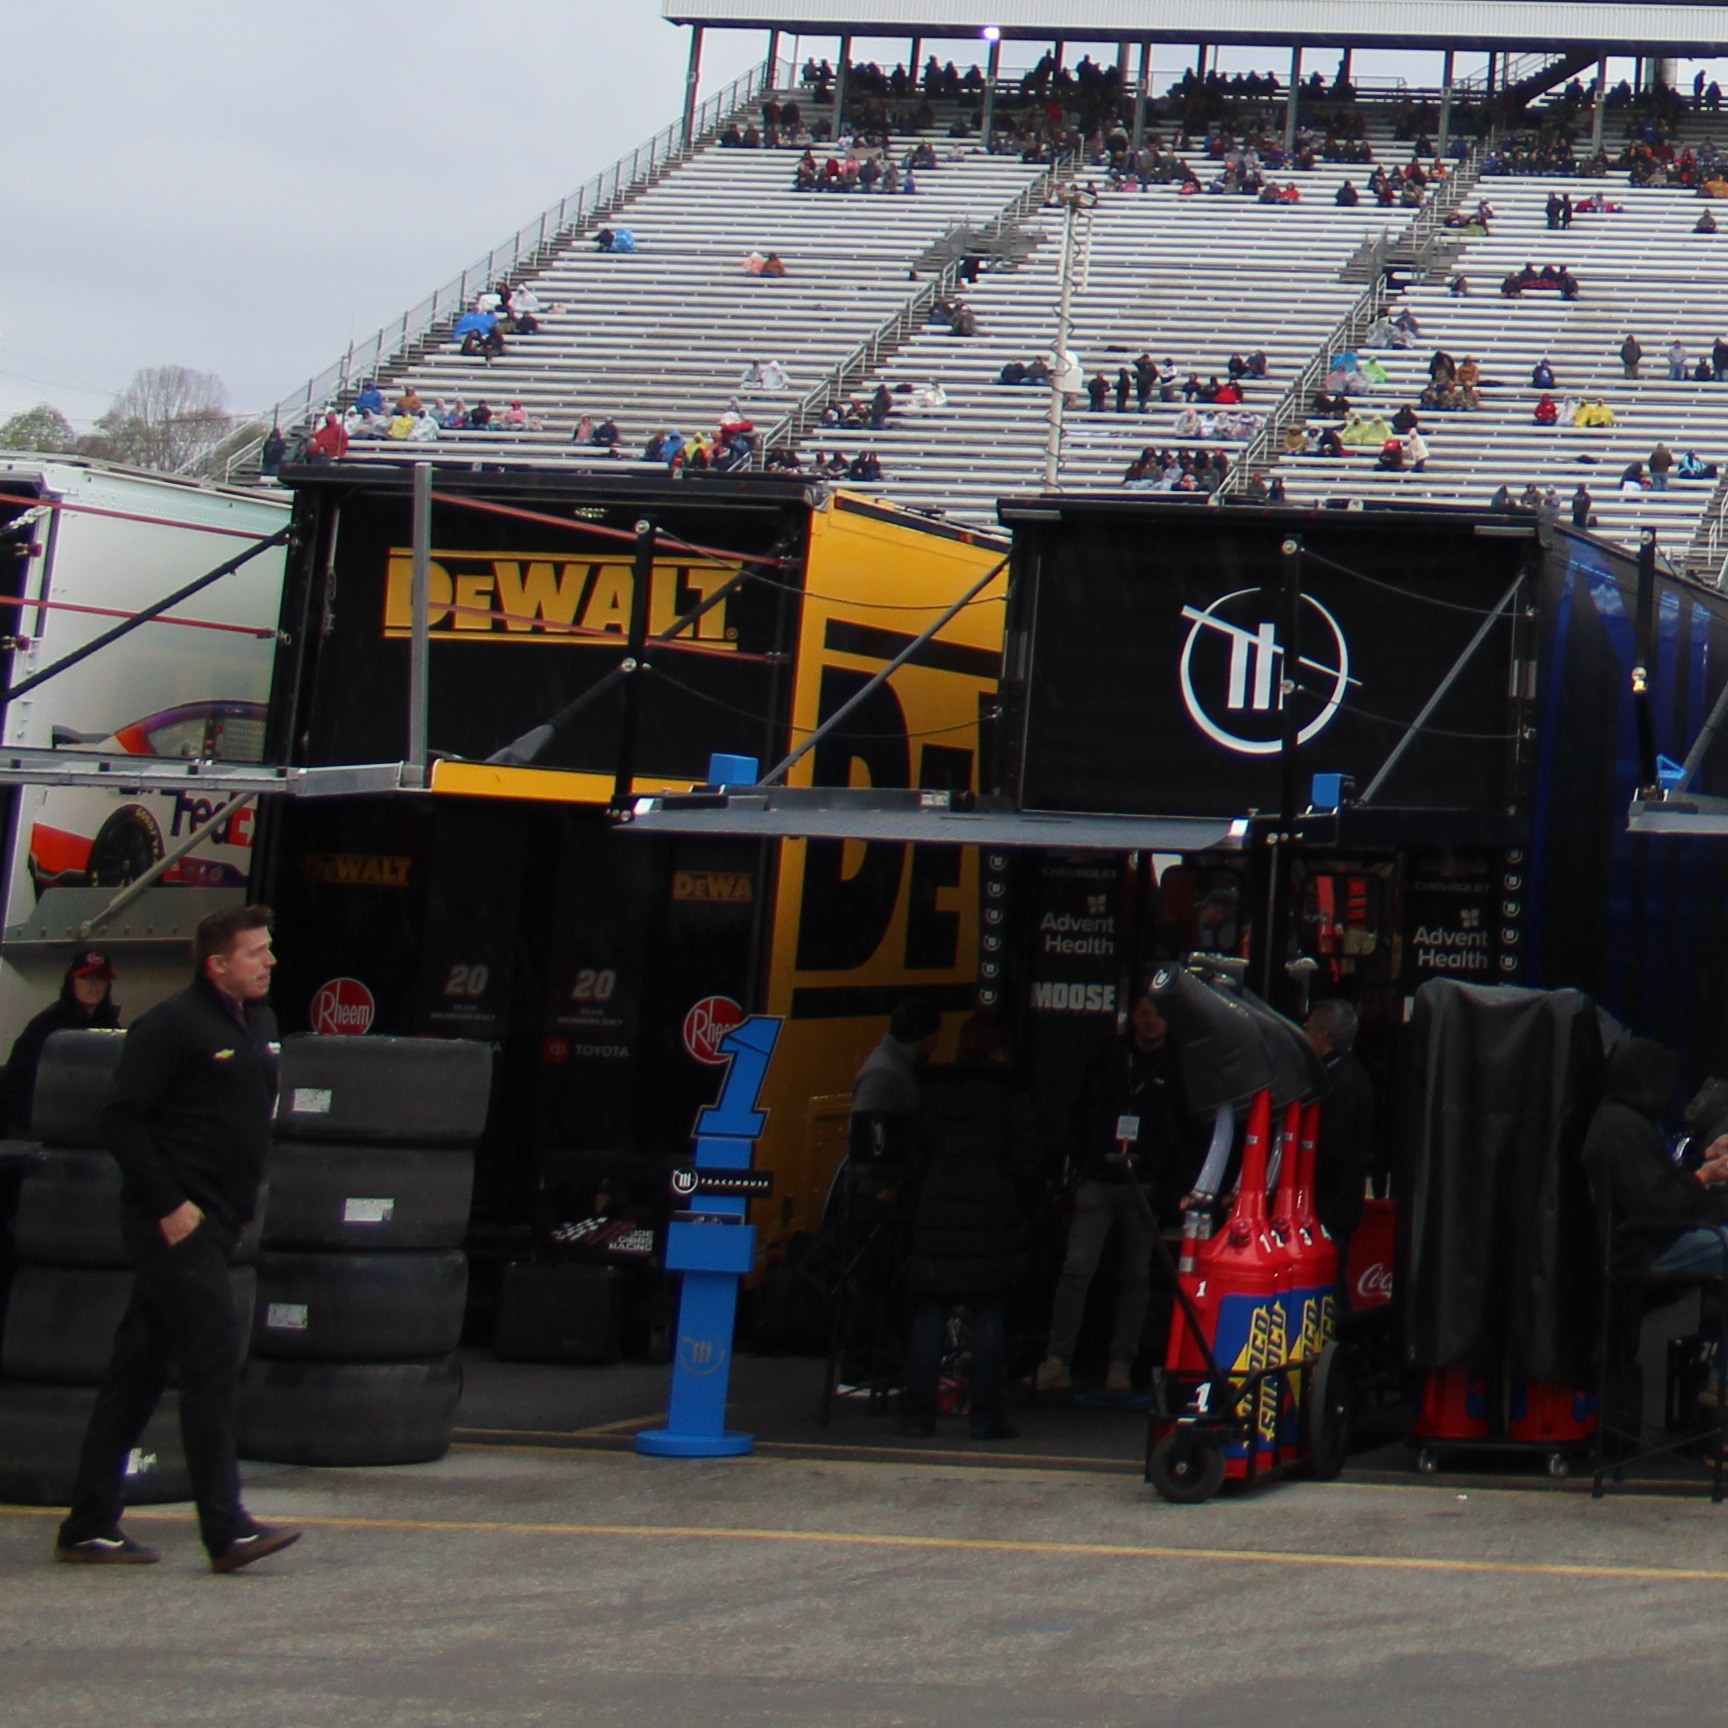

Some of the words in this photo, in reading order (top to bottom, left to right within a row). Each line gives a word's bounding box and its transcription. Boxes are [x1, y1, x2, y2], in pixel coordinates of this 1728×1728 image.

[1039, 913, 1115, 933] Advent
[1043, 934, 1114, 956] Health
[1412, 927, 1488, 947] Advent
[1416, 948, 1488, 969] Health
[443, 963, 490, 997] 20
[570, 968, 618, 1002] 20
[317, 978, 370, 1028] Rheem
[1030, 983, 1115, 1012] MOOSE
[574, 1043, 630, 1058] TOYOTA
[690, 1015, 787, 1140] 1
[700, 1176, 770, 1188] TRACKHOUSE
